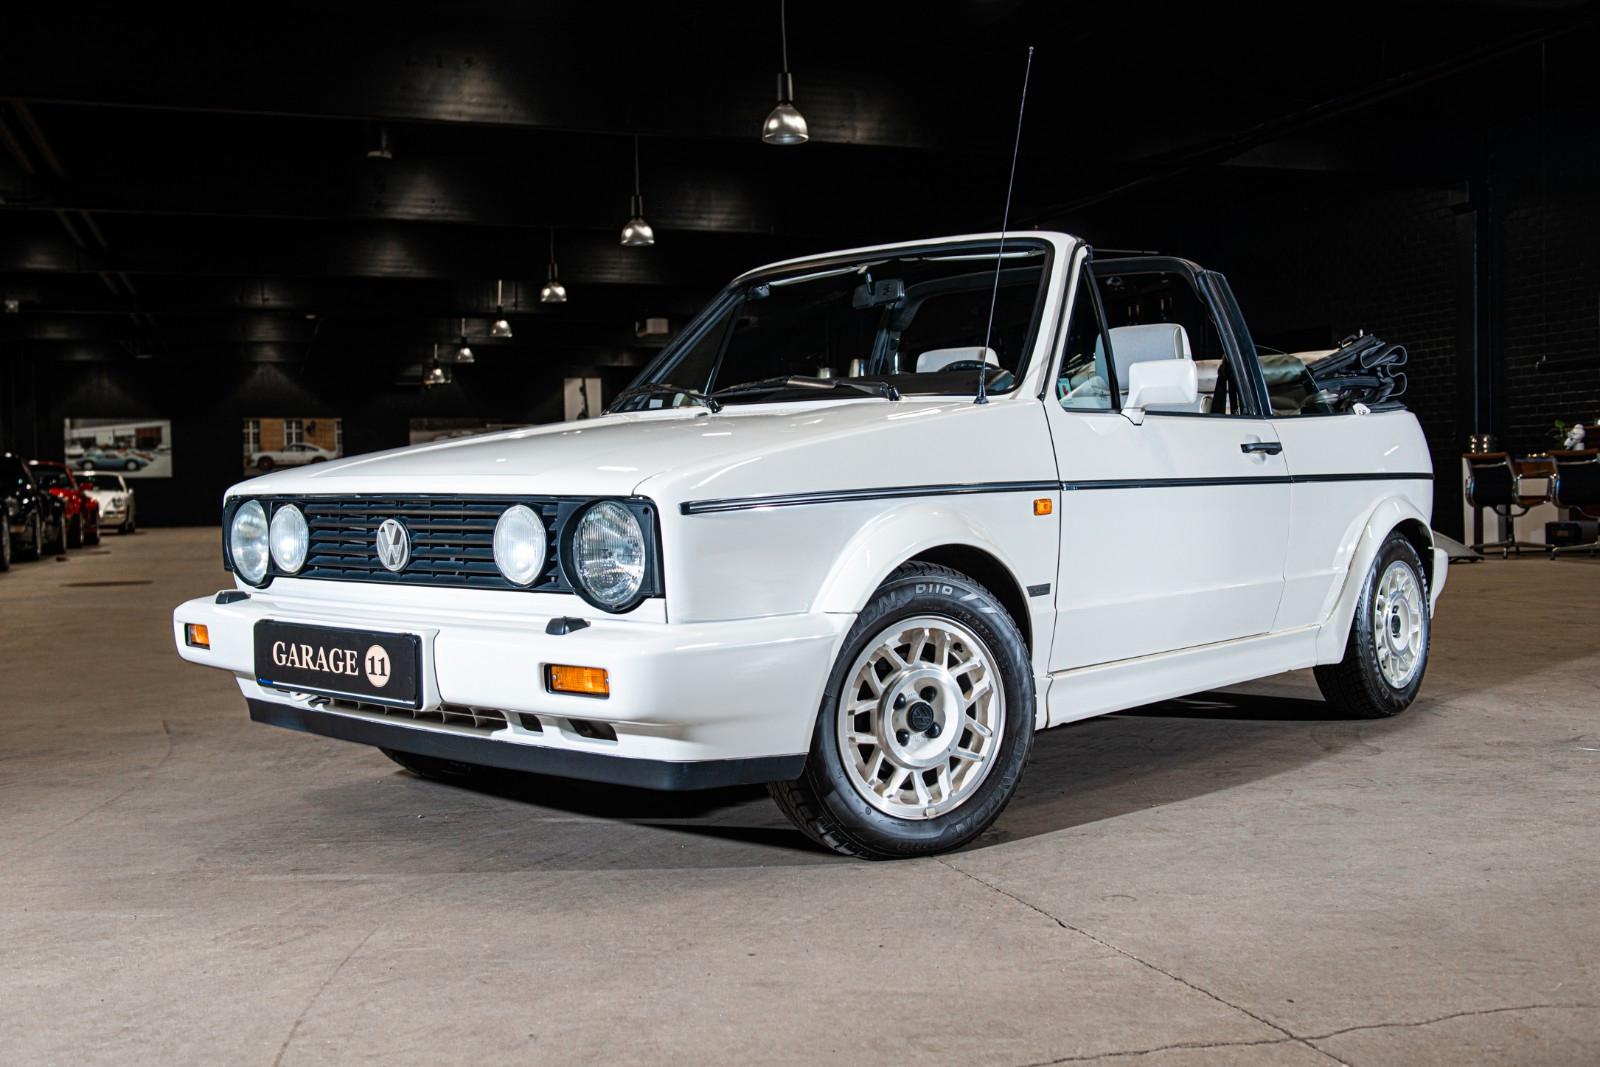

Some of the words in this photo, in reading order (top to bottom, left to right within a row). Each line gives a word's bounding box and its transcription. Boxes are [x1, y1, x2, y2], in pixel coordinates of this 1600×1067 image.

[915, 583, 953, 596] D110
[272, 641, 359, 676] GARAGE
[367, 655, 388, 677] 11
